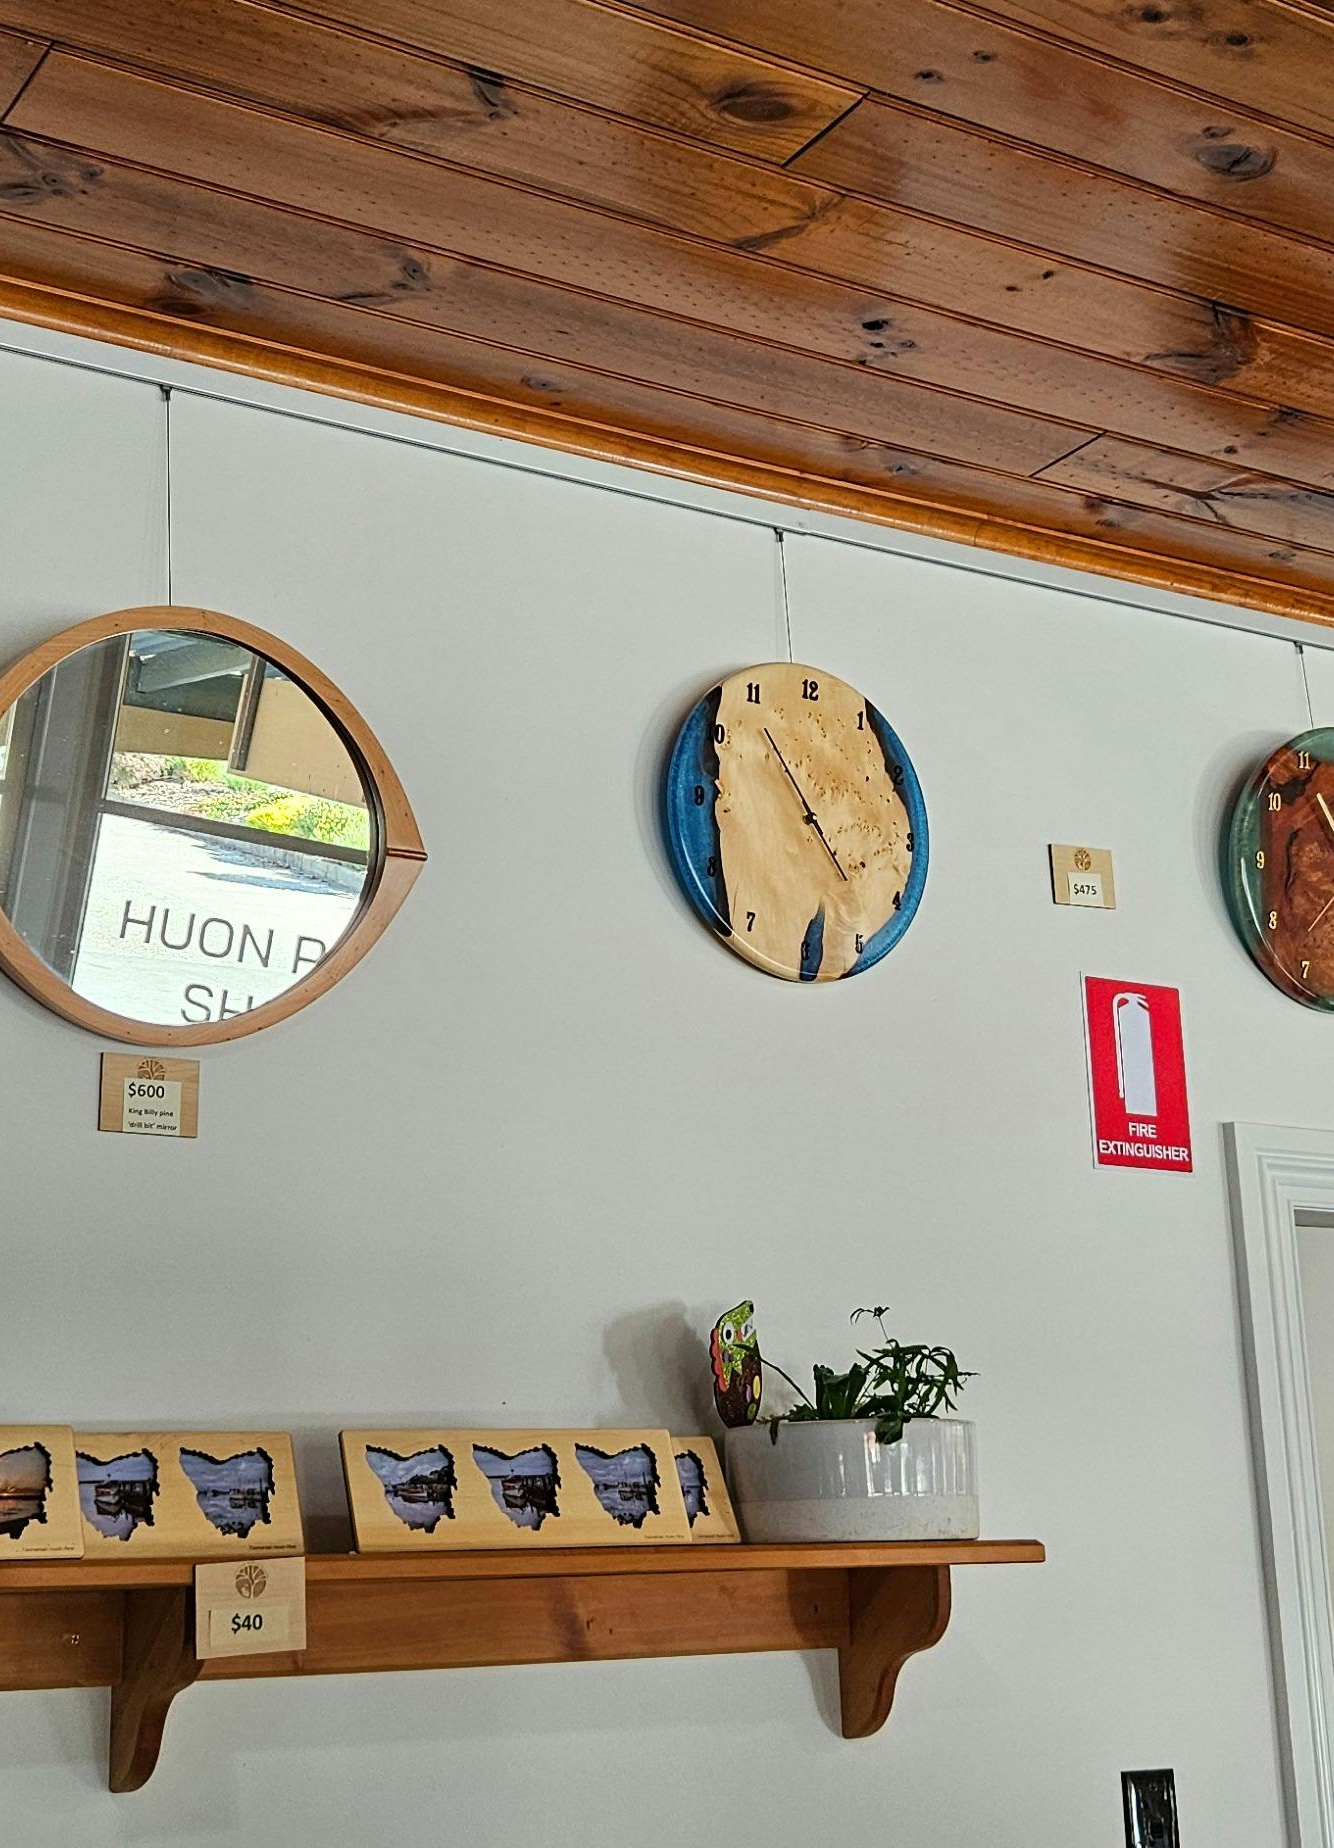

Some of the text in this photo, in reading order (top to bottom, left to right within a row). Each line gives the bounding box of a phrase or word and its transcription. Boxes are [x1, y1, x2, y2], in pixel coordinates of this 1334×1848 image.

[747, 682, 761, 704] 11
[802, 679, 819, 701] 12
[857, 711, 865, 731] 1
[1298, 751, 1311, 770] 11
[893, 764, 904, 785] 2
[694, 785, 705, 806] 9
[1268, 792, 1281, 811] 10
[707, 856, 718, 877] 8
[1256, 851, 1265, 868] 9
[1073, 883, 1097, 896] $475
[892, 891, 902, 911] 4
[746, 911, 756, 932] 7
[1269, 911, 1277, 930] 8
[119, 900, 274, 968] HUON
[855, 933, 864, 954] 5
[1301, 961, 1310, 979] 7
[128, 1082, 165, 1099] $600
[1128, 1121, 1158, 1138] FIRE
[1098, 1140, 1190, 1162] EXTINGUISHER
[231, 1613, 263, 1634] $40
